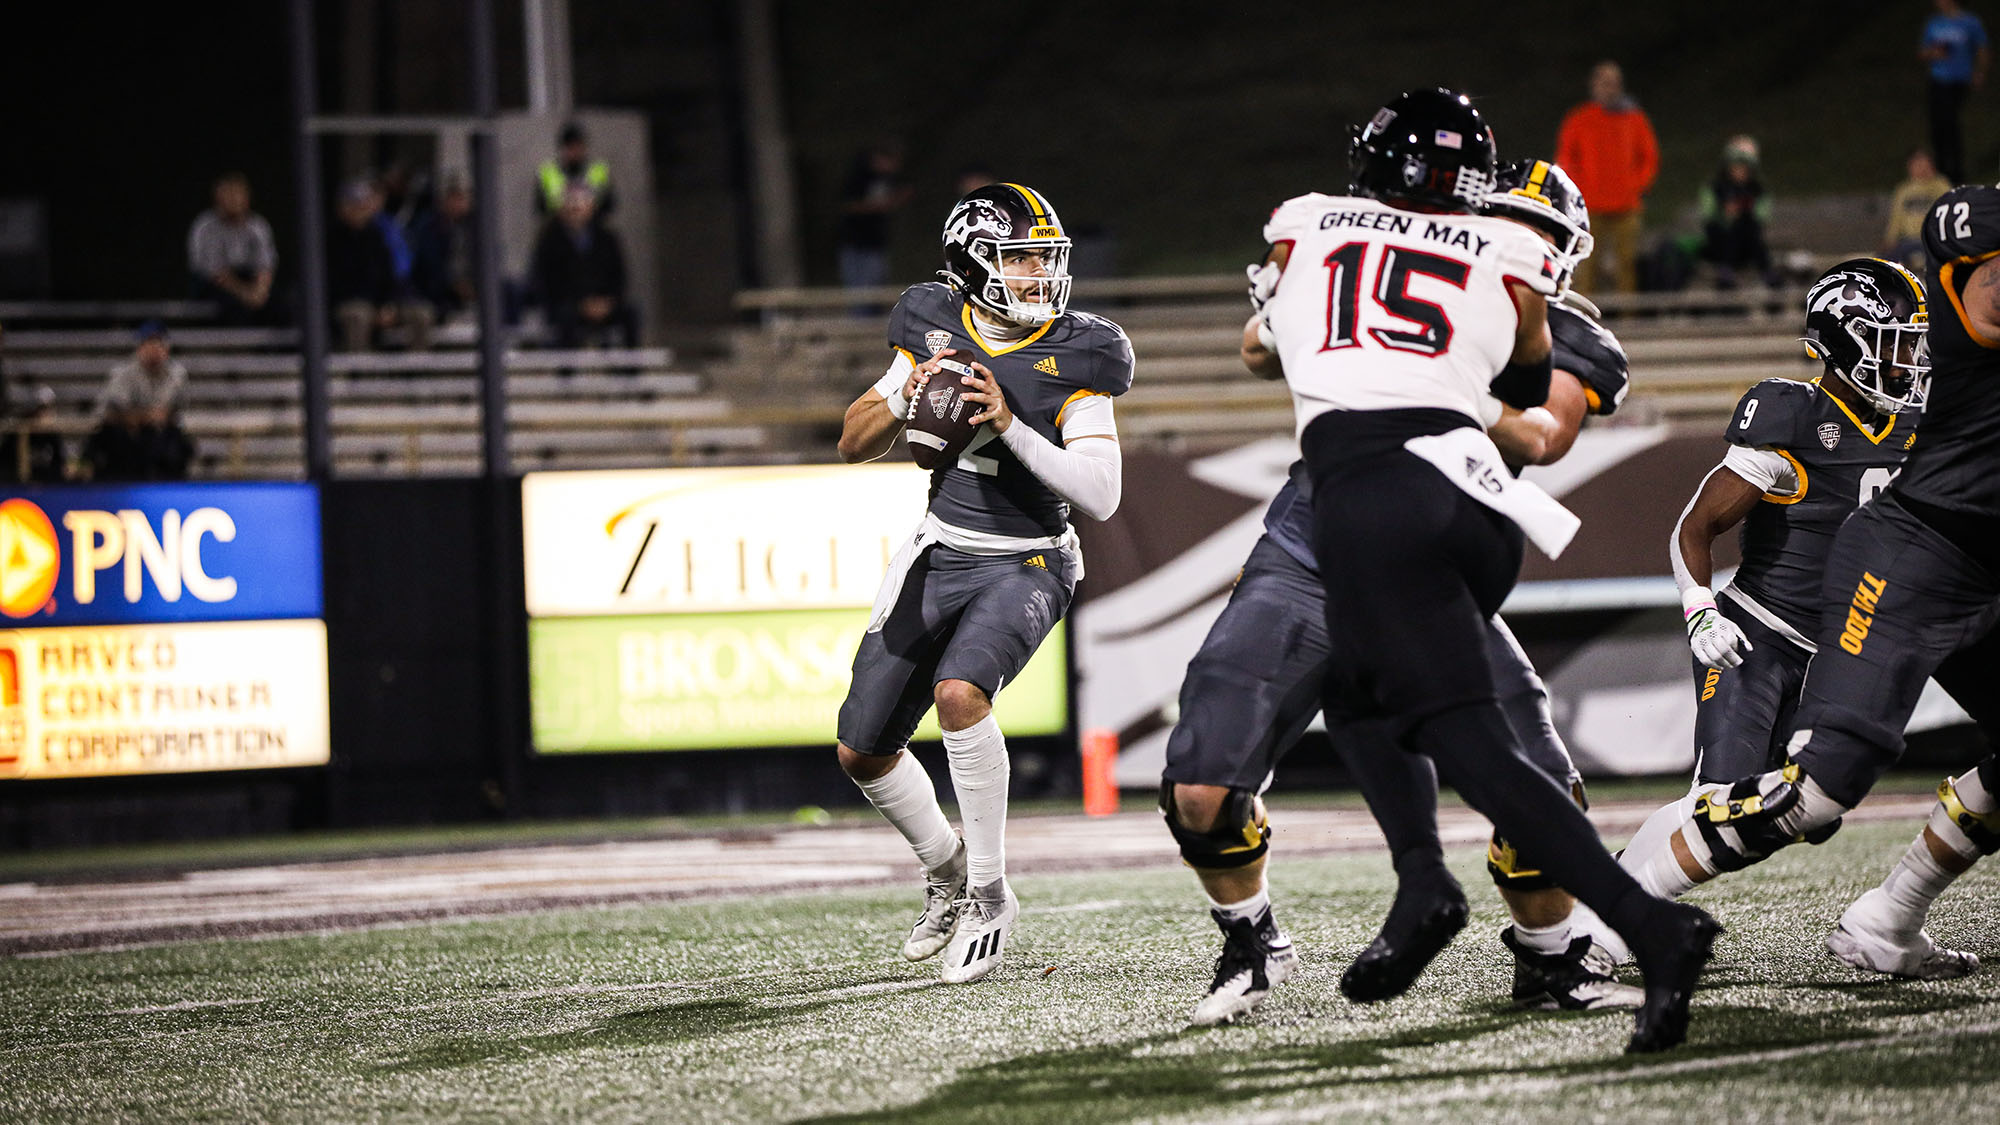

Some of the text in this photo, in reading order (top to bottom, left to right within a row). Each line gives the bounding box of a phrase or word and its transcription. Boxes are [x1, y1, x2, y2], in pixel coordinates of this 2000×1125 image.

[1035, 228, 1056, 237] WMU
[1319, 211, 1492, 256] GREEN MAY
[1935, 201, 1972, 241] 72
[1316, 241, 1472, 358] 15
[1032, 362, 1060, 377] adidas
[1738, 398, 1759, 430] 9
[1820, 430, 1841, 439] MAC
[1479, 467, 1503, 494] 15
[63, 507, 238, 604] PNC
[43, 730, 286, 763] CORPORATION
